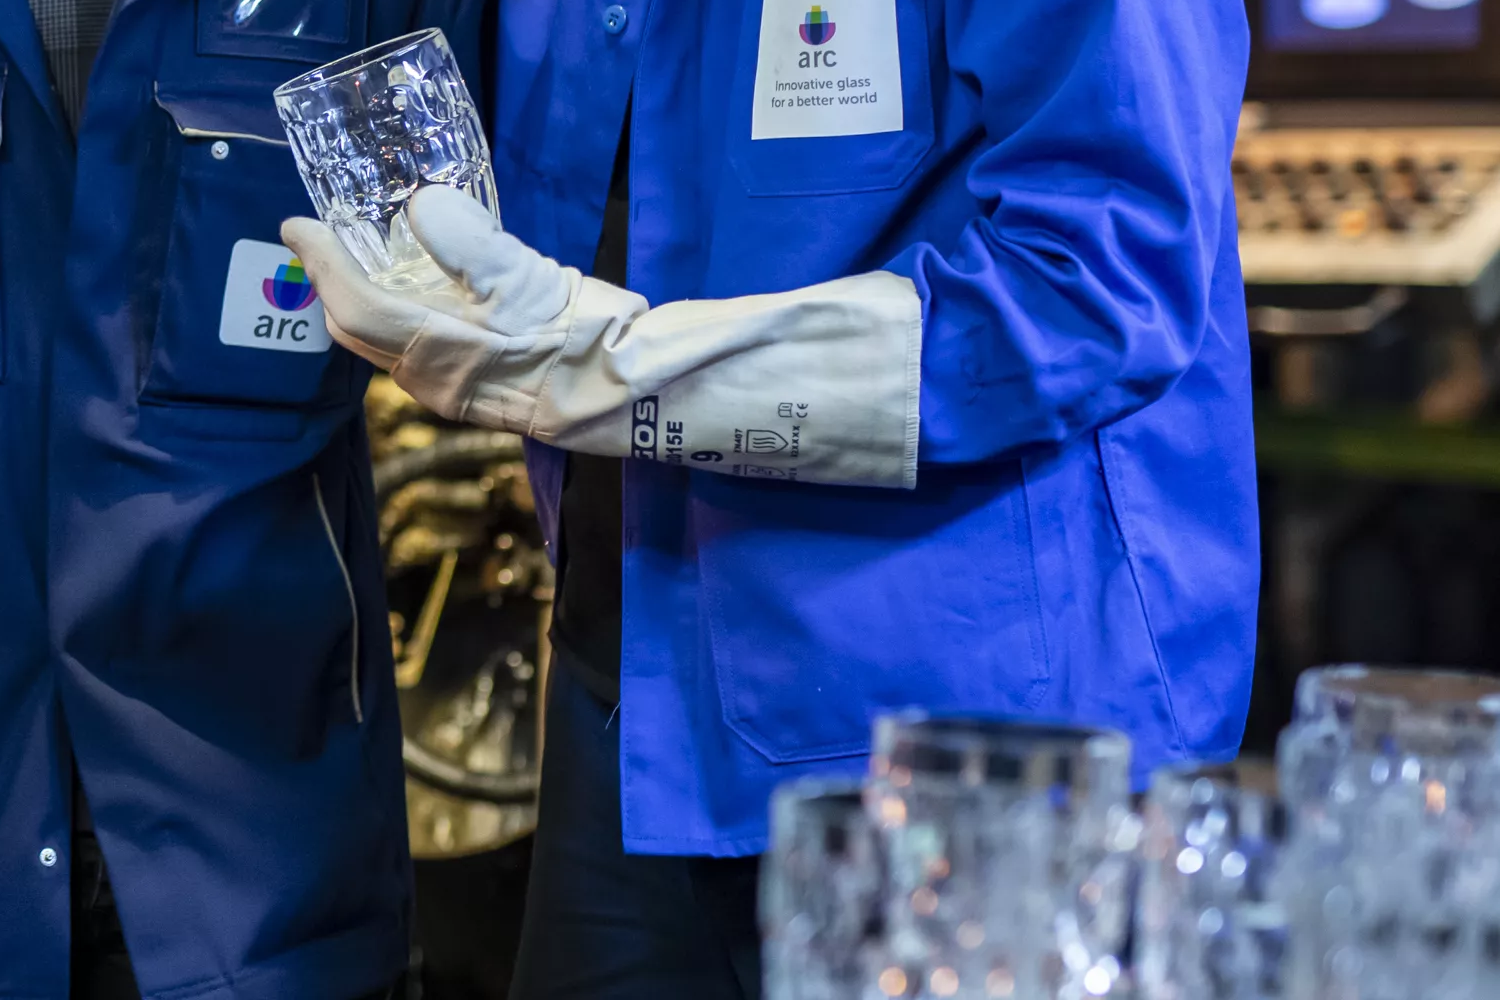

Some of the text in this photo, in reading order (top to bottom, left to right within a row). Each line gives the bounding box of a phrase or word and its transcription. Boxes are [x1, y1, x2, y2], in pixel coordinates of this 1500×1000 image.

[798, 50, 838, 68] arc
[775, 77, 871, 91] Innovative glass
[771, 92, 878, 108] for a better world
[253, 314, 310, 342] arc
[690, 450, 724, 462] 9
